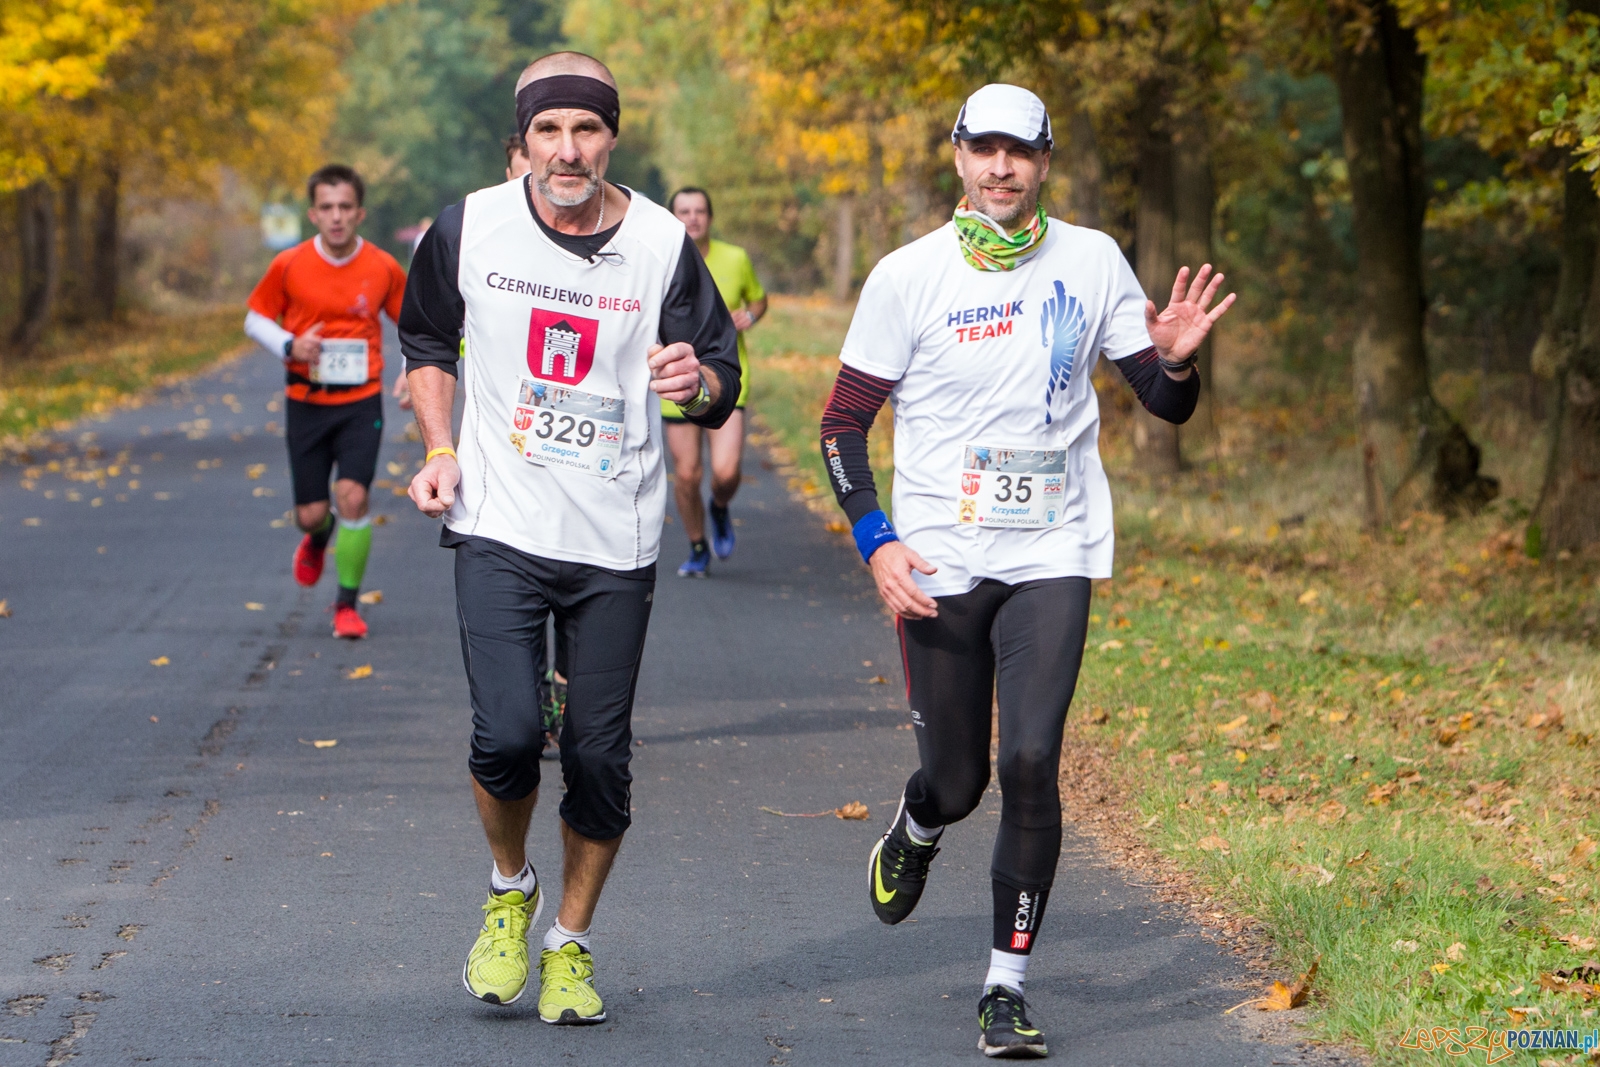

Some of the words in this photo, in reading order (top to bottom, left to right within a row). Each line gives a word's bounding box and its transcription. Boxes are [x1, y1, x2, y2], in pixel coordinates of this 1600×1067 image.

[487, 272, 593, 307] CZERNIEJEWO
[598, 296, 641, 312] BIEGA
[947, 300, 1024, 327] HERNIK
[956, 320, 1012, 343] TEAM
[535, 411, 596, 447] 329
[532, 453, 565, 465] POLINOVA
[565, 461, 591, 470] POLSKA
[541, 443, 580, 458] Grzegorz
[994, 475, 1033, 503] 35
[991, 506, 1031, 516] Krzysztof
